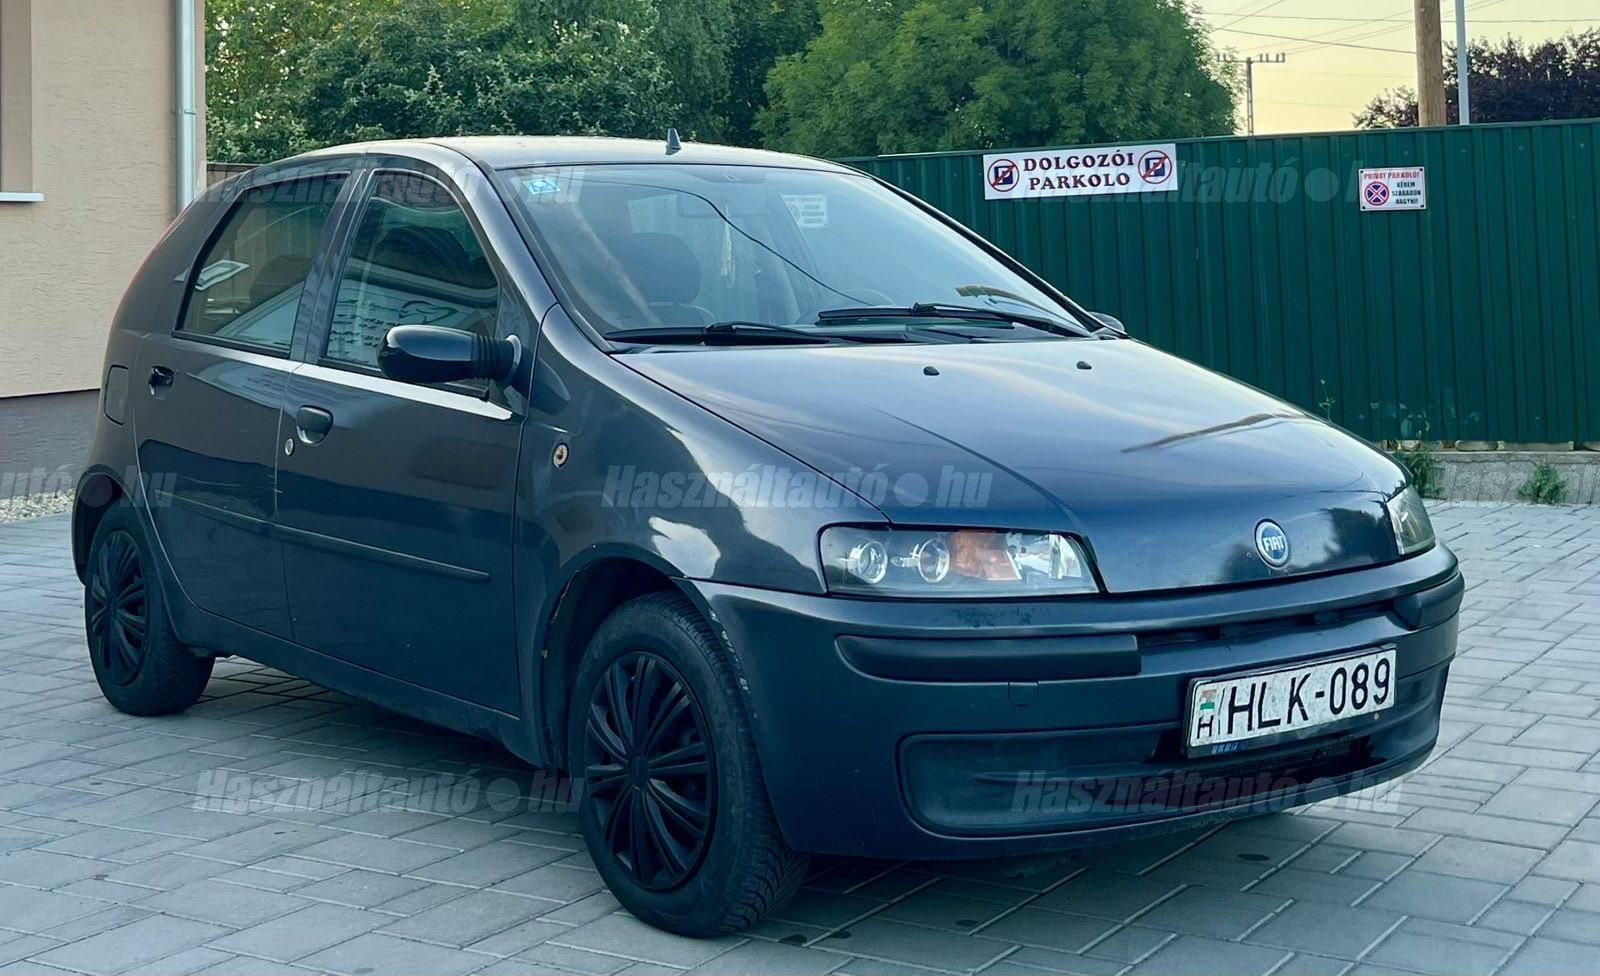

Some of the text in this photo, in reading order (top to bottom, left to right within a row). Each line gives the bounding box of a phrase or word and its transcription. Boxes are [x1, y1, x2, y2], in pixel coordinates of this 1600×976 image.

[1023, 149, 1135, 171] DOLGOZÓI
[1029, 172, 1130, 190] PARKOLO
[1262, 535, 1285, 552] FIAT
[1196, 657, 1391, 739] H HLK-089
